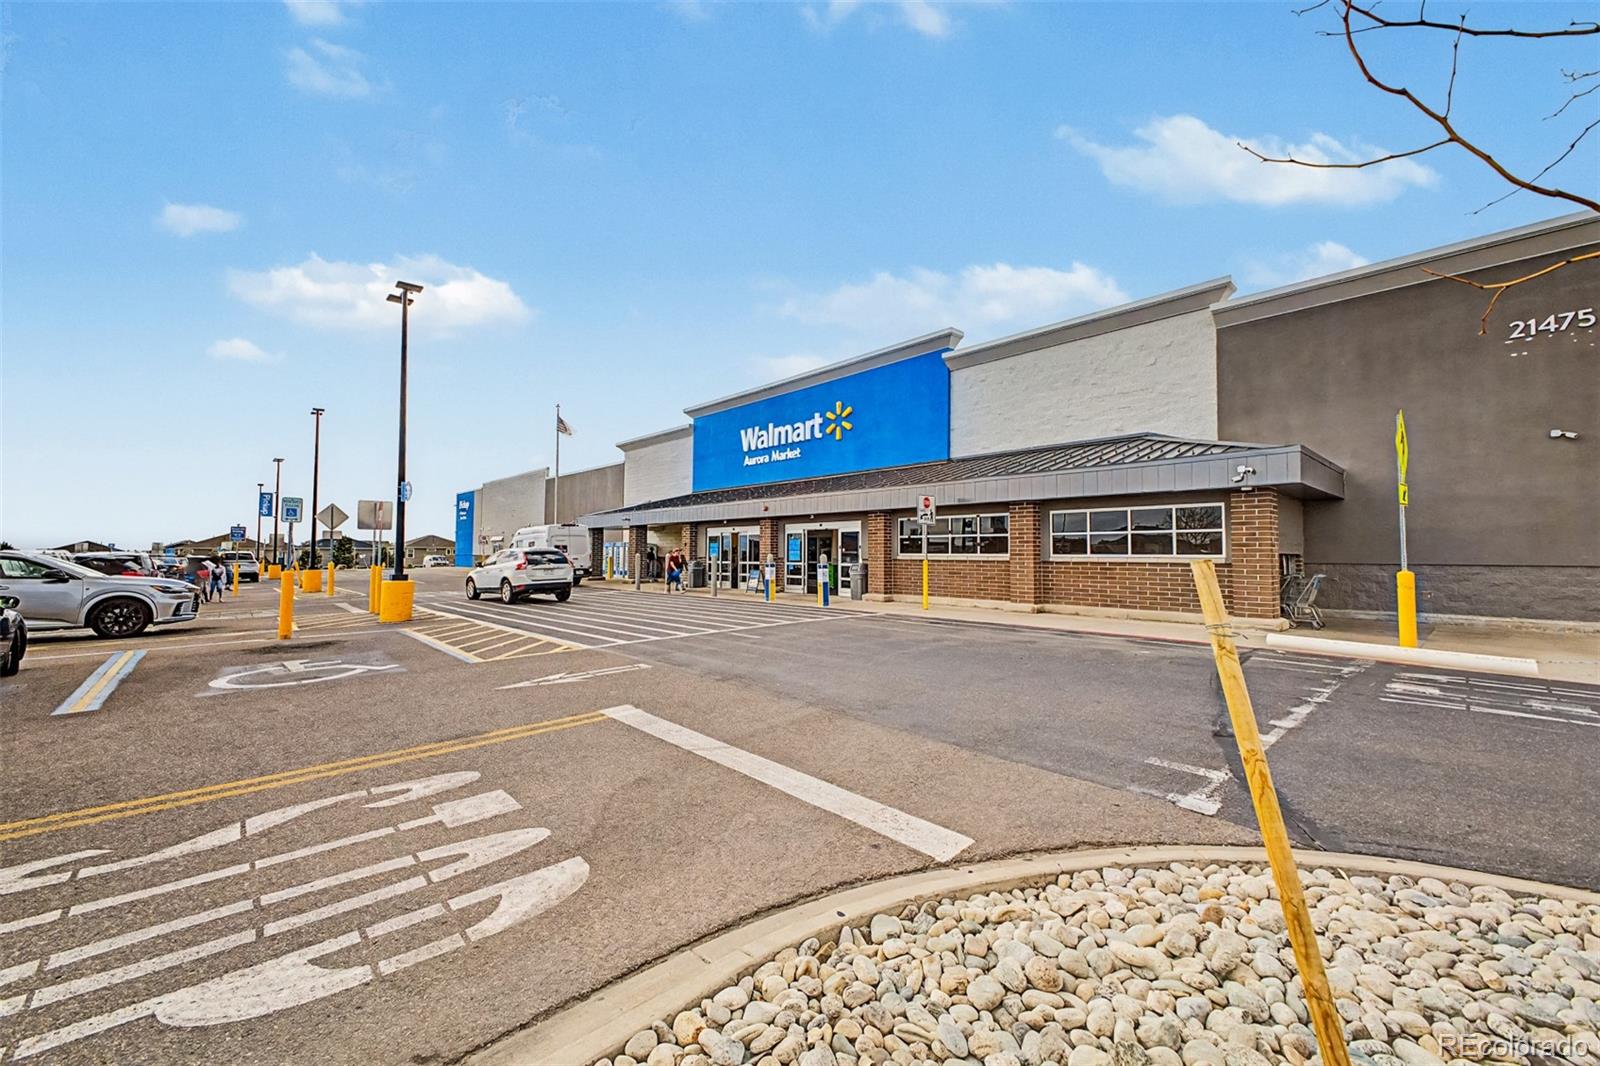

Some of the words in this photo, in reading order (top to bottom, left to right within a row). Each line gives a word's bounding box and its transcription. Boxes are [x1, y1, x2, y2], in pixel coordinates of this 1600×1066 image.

[1508, 308, 1597, 339] 21475
[740, 412, 823, 452] Walmart
[743, 452, 769, 466] Aurora
[770, 447, 801, 462] Market
